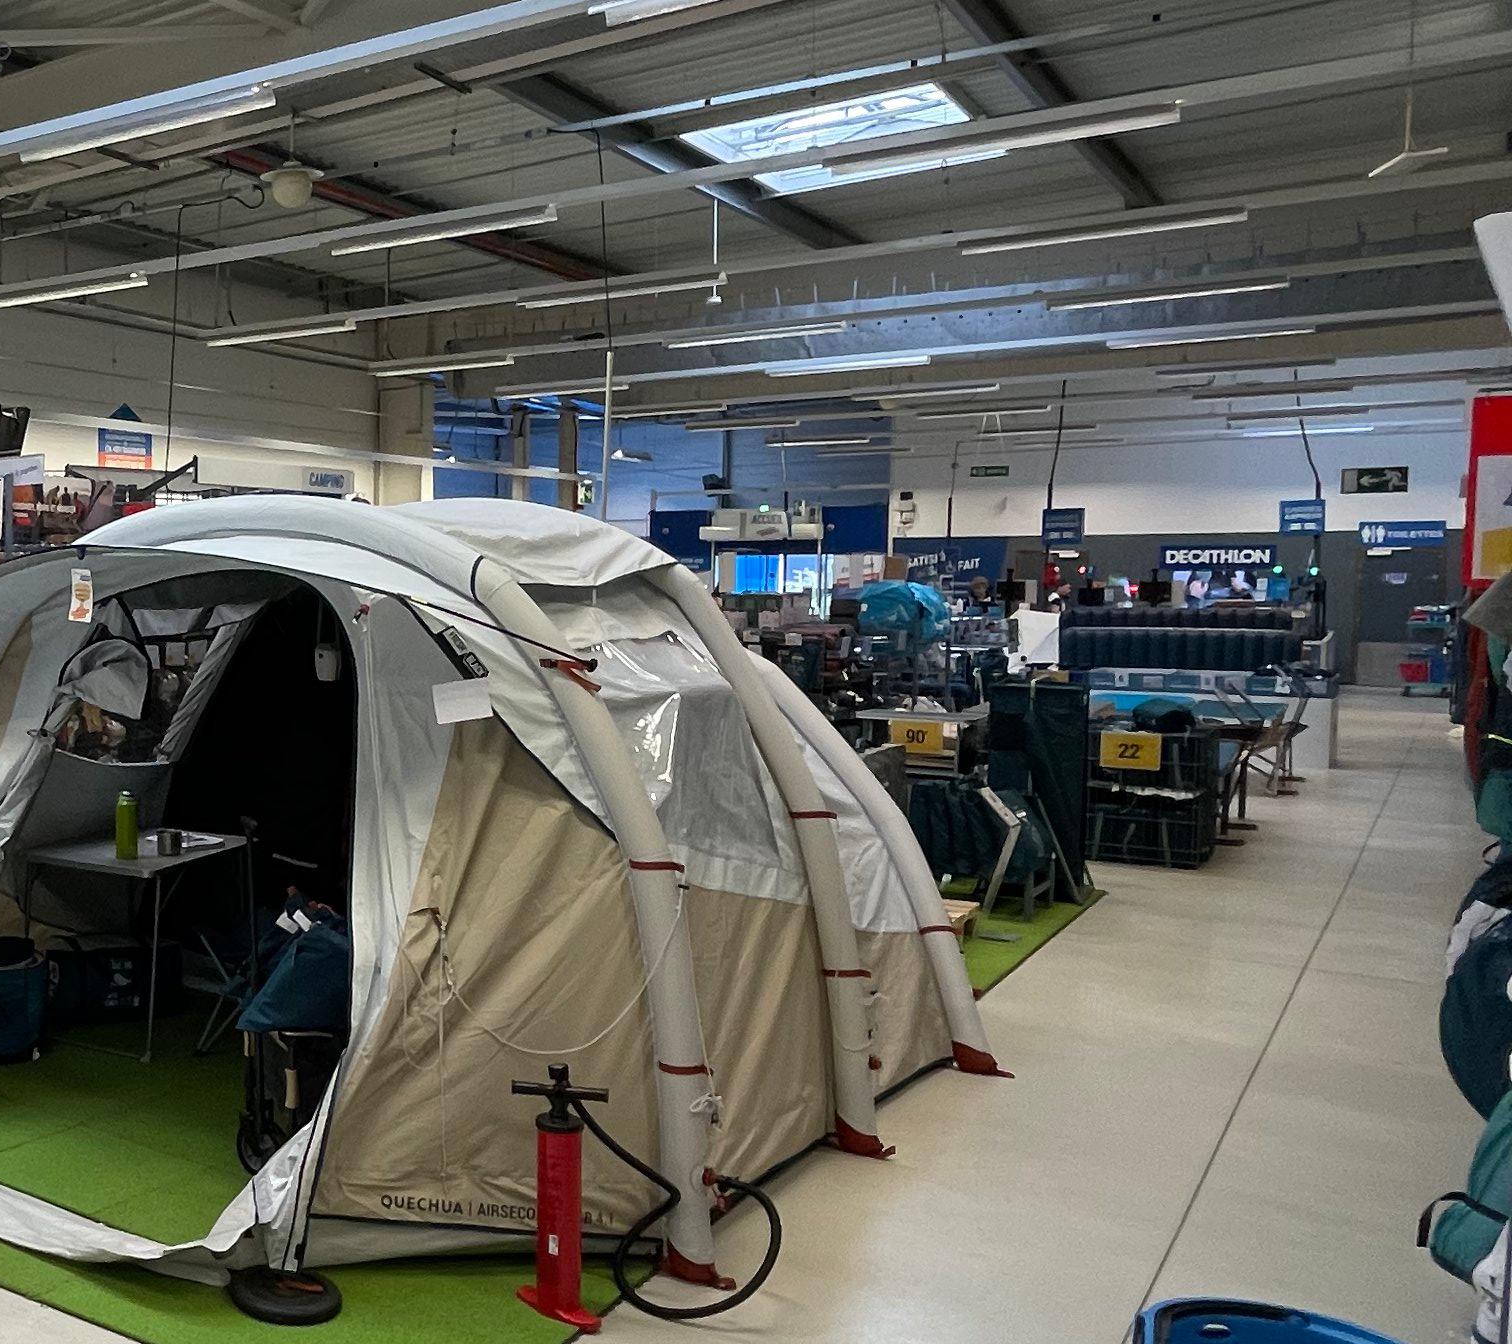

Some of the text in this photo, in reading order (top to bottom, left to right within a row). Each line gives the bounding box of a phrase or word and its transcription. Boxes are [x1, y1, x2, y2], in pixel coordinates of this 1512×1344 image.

[1164, 548, 1271, 565] DECATHLON
[381, 1194, 464, 1216] QUECHUA
[477, 1203, 536, 1221] AIRSECO
